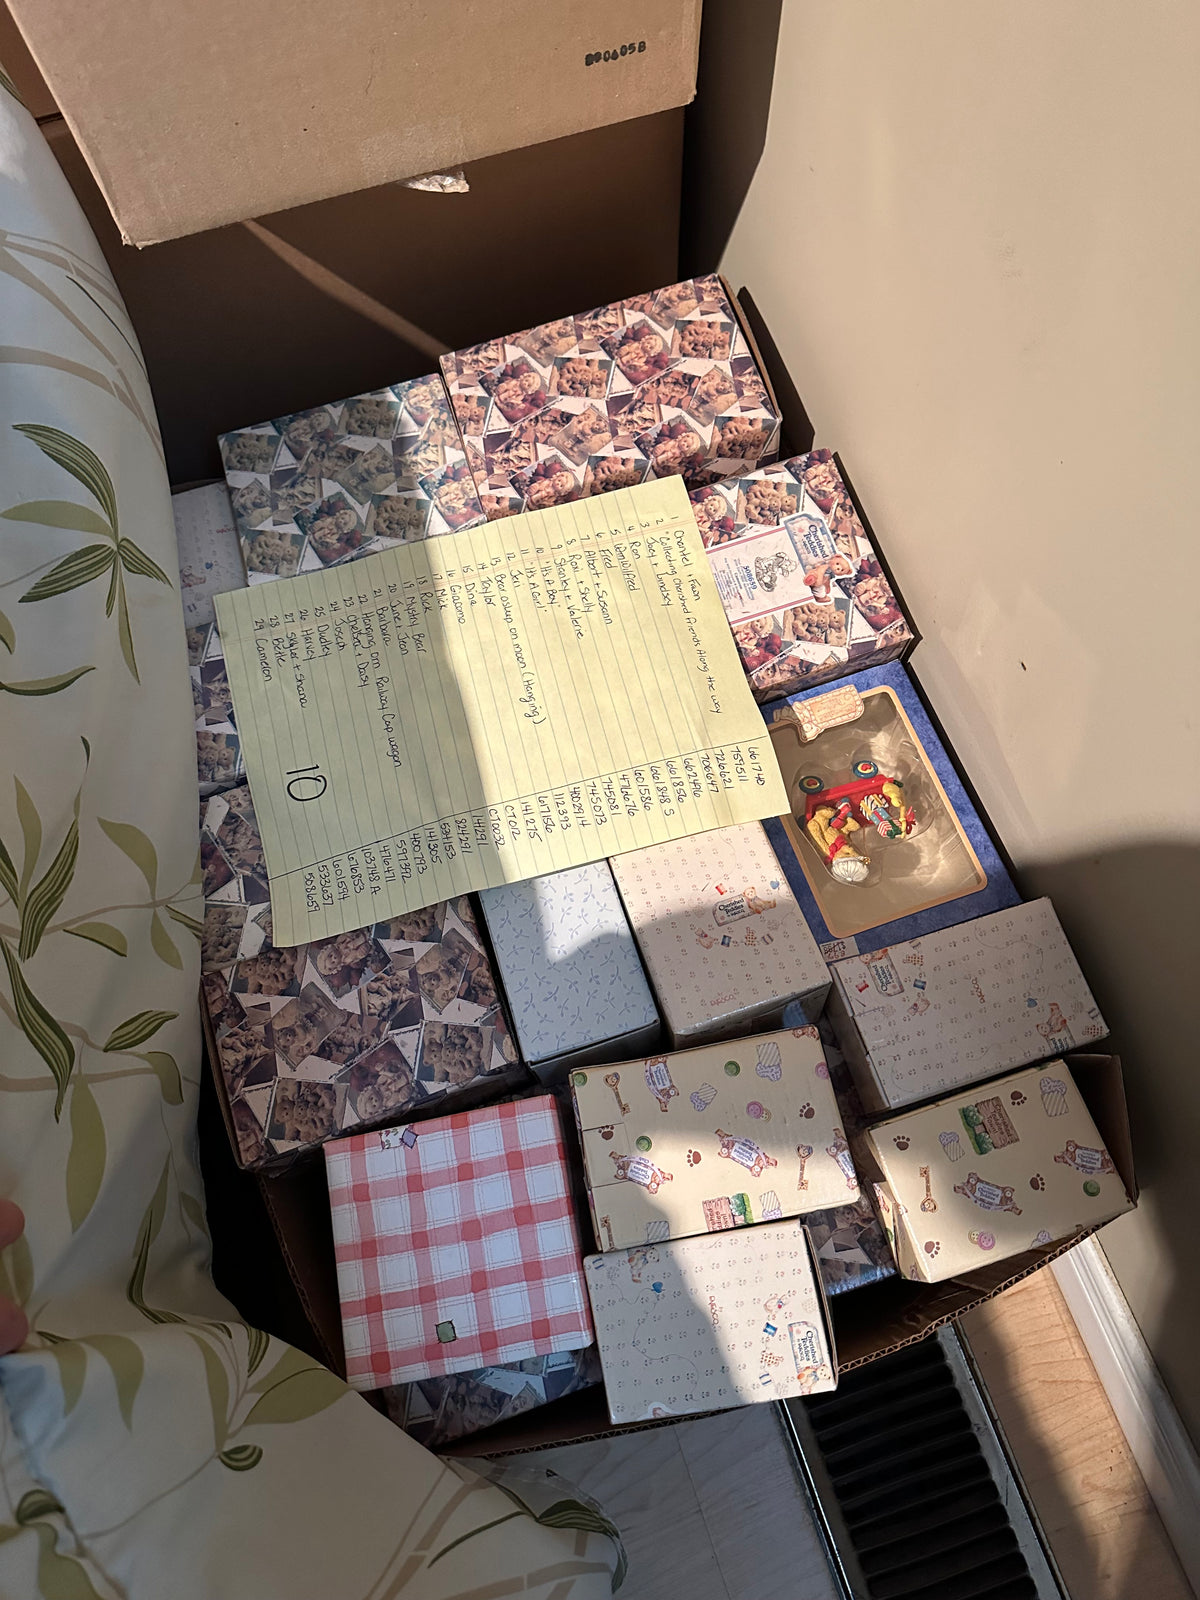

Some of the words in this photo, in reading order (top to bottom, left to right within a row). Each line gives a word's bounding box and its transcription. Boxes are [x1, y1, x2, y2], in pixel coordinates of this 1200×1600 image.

[609, 528, 621, 536] 5
[802, 530, 819, 559] Teddies
[807, 522, 829, 559] Cherished
[477, 562, 488, 570] 14
[489, 556, 502, 566] 13
[506, 552, 516, 561] 12
[598, 548, 618, 569] Fred
[628, 540, 642, 560] Ron
[673, 530, 692, 567] Chantel
[688, 578, 701, 601] Fawn
[416, 575, 428, 586] 18
[445, 569, 456, 578] 16
[462, 564, 474, 573] 15
[494, 573, 507, 591] Bear
[509, 569, 524, 588] Jeri
[528, 582, 540, 590] A
[565, 538, 577, 546] 8
[578, 586, 595, 613] Shelly
[646, 536, 660, 558] Joey
[656, 571, 673, 606] Lindsey
[357, 593, 369, 605] 22
[372, 588, 383, 599] 21
[387, 583, 397, 594] 20
[419, 591, 434, 614] Rick
[434, 588, 448, 610] Mick
[449, 584, 466, 624] Giacomo
[464, 582, 478, 607] Dina
[478, 576, 496, 607] Taylor
[553, 557, 570, 592] Stanley
[566, 604, 584, 639] Valerie
[583, 550, 602, 578] Albert
[596, 590, 613, 625] Susann
[269, 614, 281, 628] 28
[298, 608, 309, 621] 26
[314, 605, 327, 618] 25
[329, 600, 341, 613] 24
[389, 599, 406, 624] June
[402, 580, 415, 589] 19
[411, 632, 427, 653] Bear
[253, 618, 265, 632] 29
[312, 623, 334, 658] Dudley
[333, 617, 349, 651] Joseph
[342, 596, 355, 608] 23
[356, 661, 370, 688] Daisy
[353, 611, 377, 649] Hanging
[375, 605, 392, 647] Barbara
[508, 627, 519, 640] on
[255, 638, 273, 682] Cameron
[283, 612, 296, 624] 27
[294, 673, 308, 708] Shana
[300, 627, 320, 662] Harvey
[396, 632, 410, 656] Jean
[513, 643, 527, 669] moon
[696, 649, 709, 672] Along
[375, 676, 390, 711] Railway
[706, 675, 715, 691] the
[709, 694, 722, 714] way
[385, 736, 402, 768] wagon
[714, 749, 734, 789] 726621
[730, 745, 748, 782] 759511
[747, 746, 766, 786] 661740
[285, 763, 328, 802] 10
[633, 769, 653, 811] 601586
[649, 765, 671, 804] 661848
[665, 760, 687, 803] 661856
[700, 752, 720, 793] 706647
[554, 792, 572, 830] 112393
[587, 781, 607, 826] 745073
[601, 777, 622, 816] 745081
[619, 773, 639, 817] 476676
[537, 795, 556, 833] 617156
[423, 827, 443, 864] 141305
[439, 822, 457, 860] 534153
[454, 818, 473, 854] 824291
[346, 851, 365, 894] 676853
[360, 847, 381, 883] 103748
[378, 844, 396, 883] 476471
[395, 839, 412, 884] 597392
[303, 872, 321, 913] 508659
[317, 864, 334, 906] 533637
[331, 858, 351, 901] 601594
[369, 885, 382, 895] A
[717, 897, 745, 911] Cherished
[723, 903, 744, 914] Teddies
[800, 1336, 813, 1361] Teddies
[804, 1329, 820, 1364] Cherished
